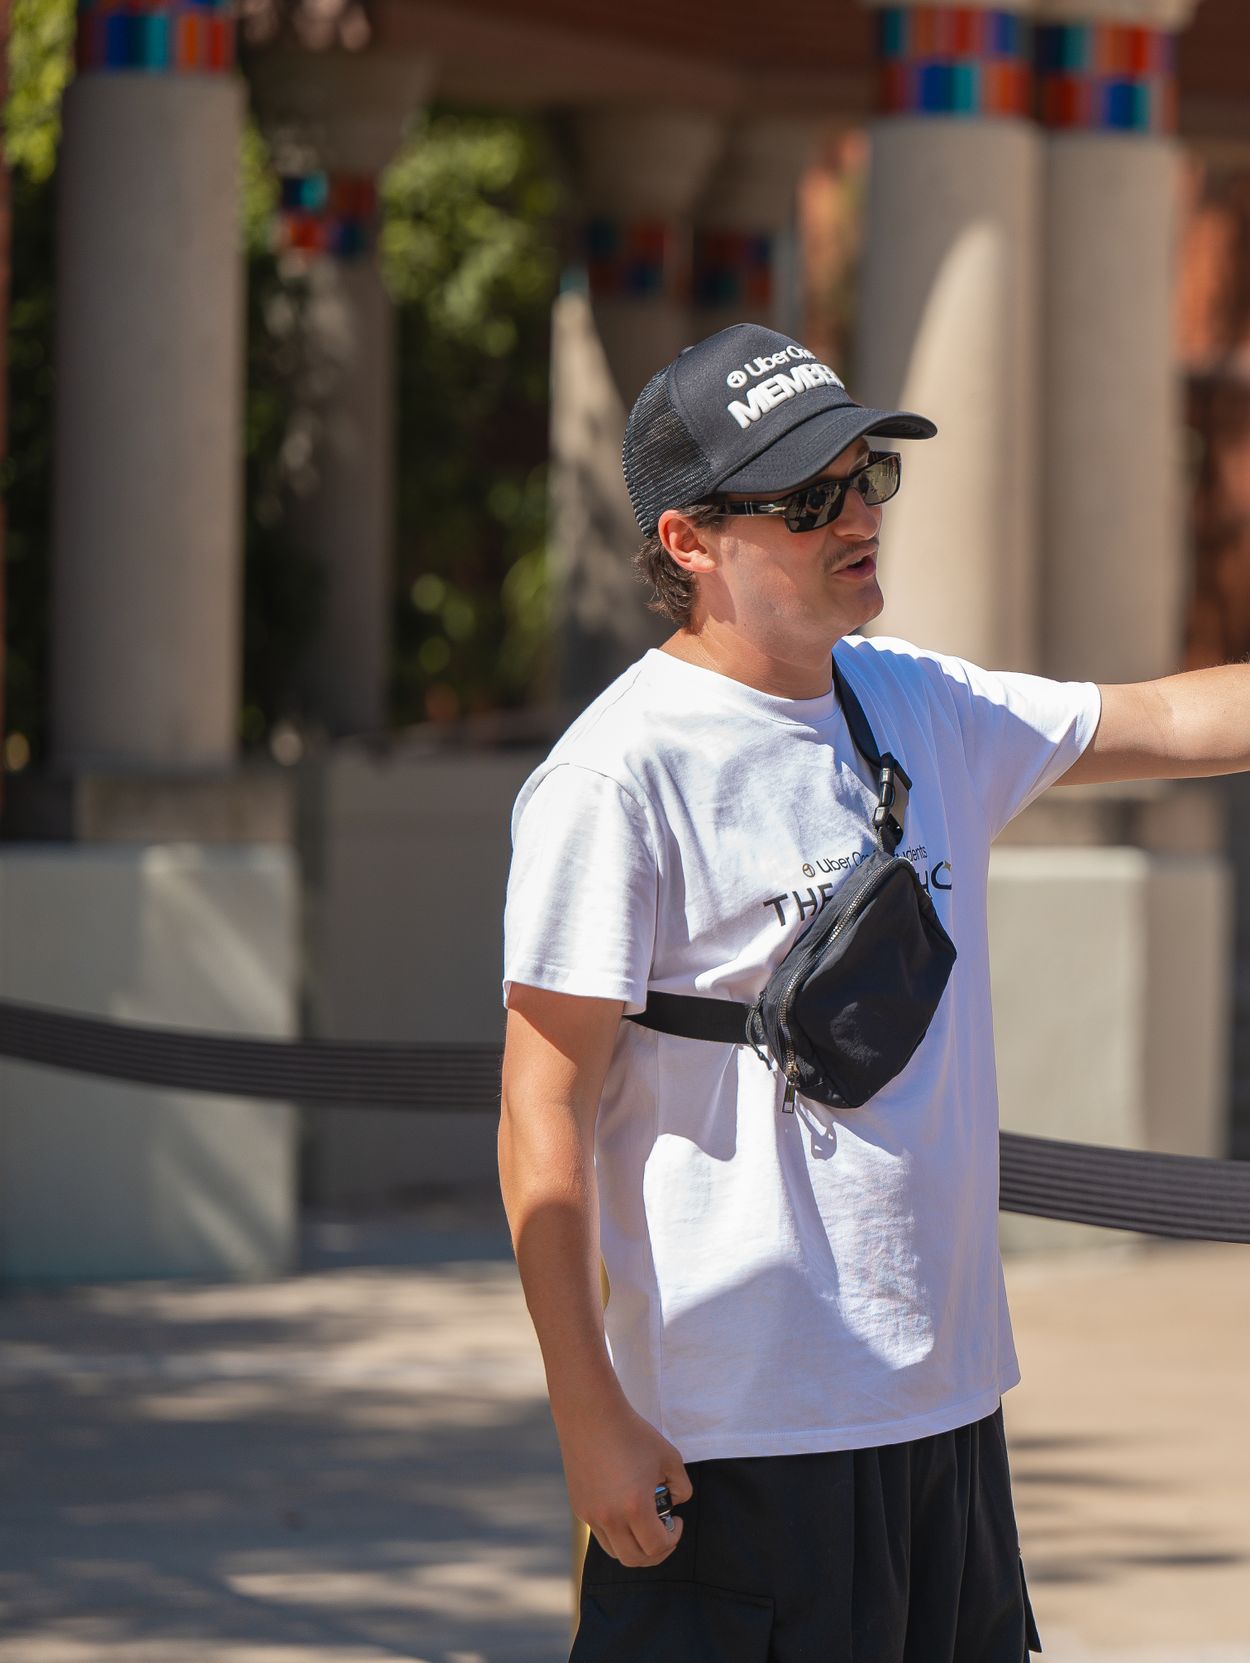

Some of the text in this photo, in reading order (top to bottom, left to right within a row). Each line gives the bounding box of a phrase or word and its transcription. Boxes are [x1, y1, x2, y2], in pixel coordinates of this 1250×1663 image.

[744, 350, 790, 377] Uber
[727, 363, 846, 429] MEMBE
[816, 855, 851, 874] Uber
